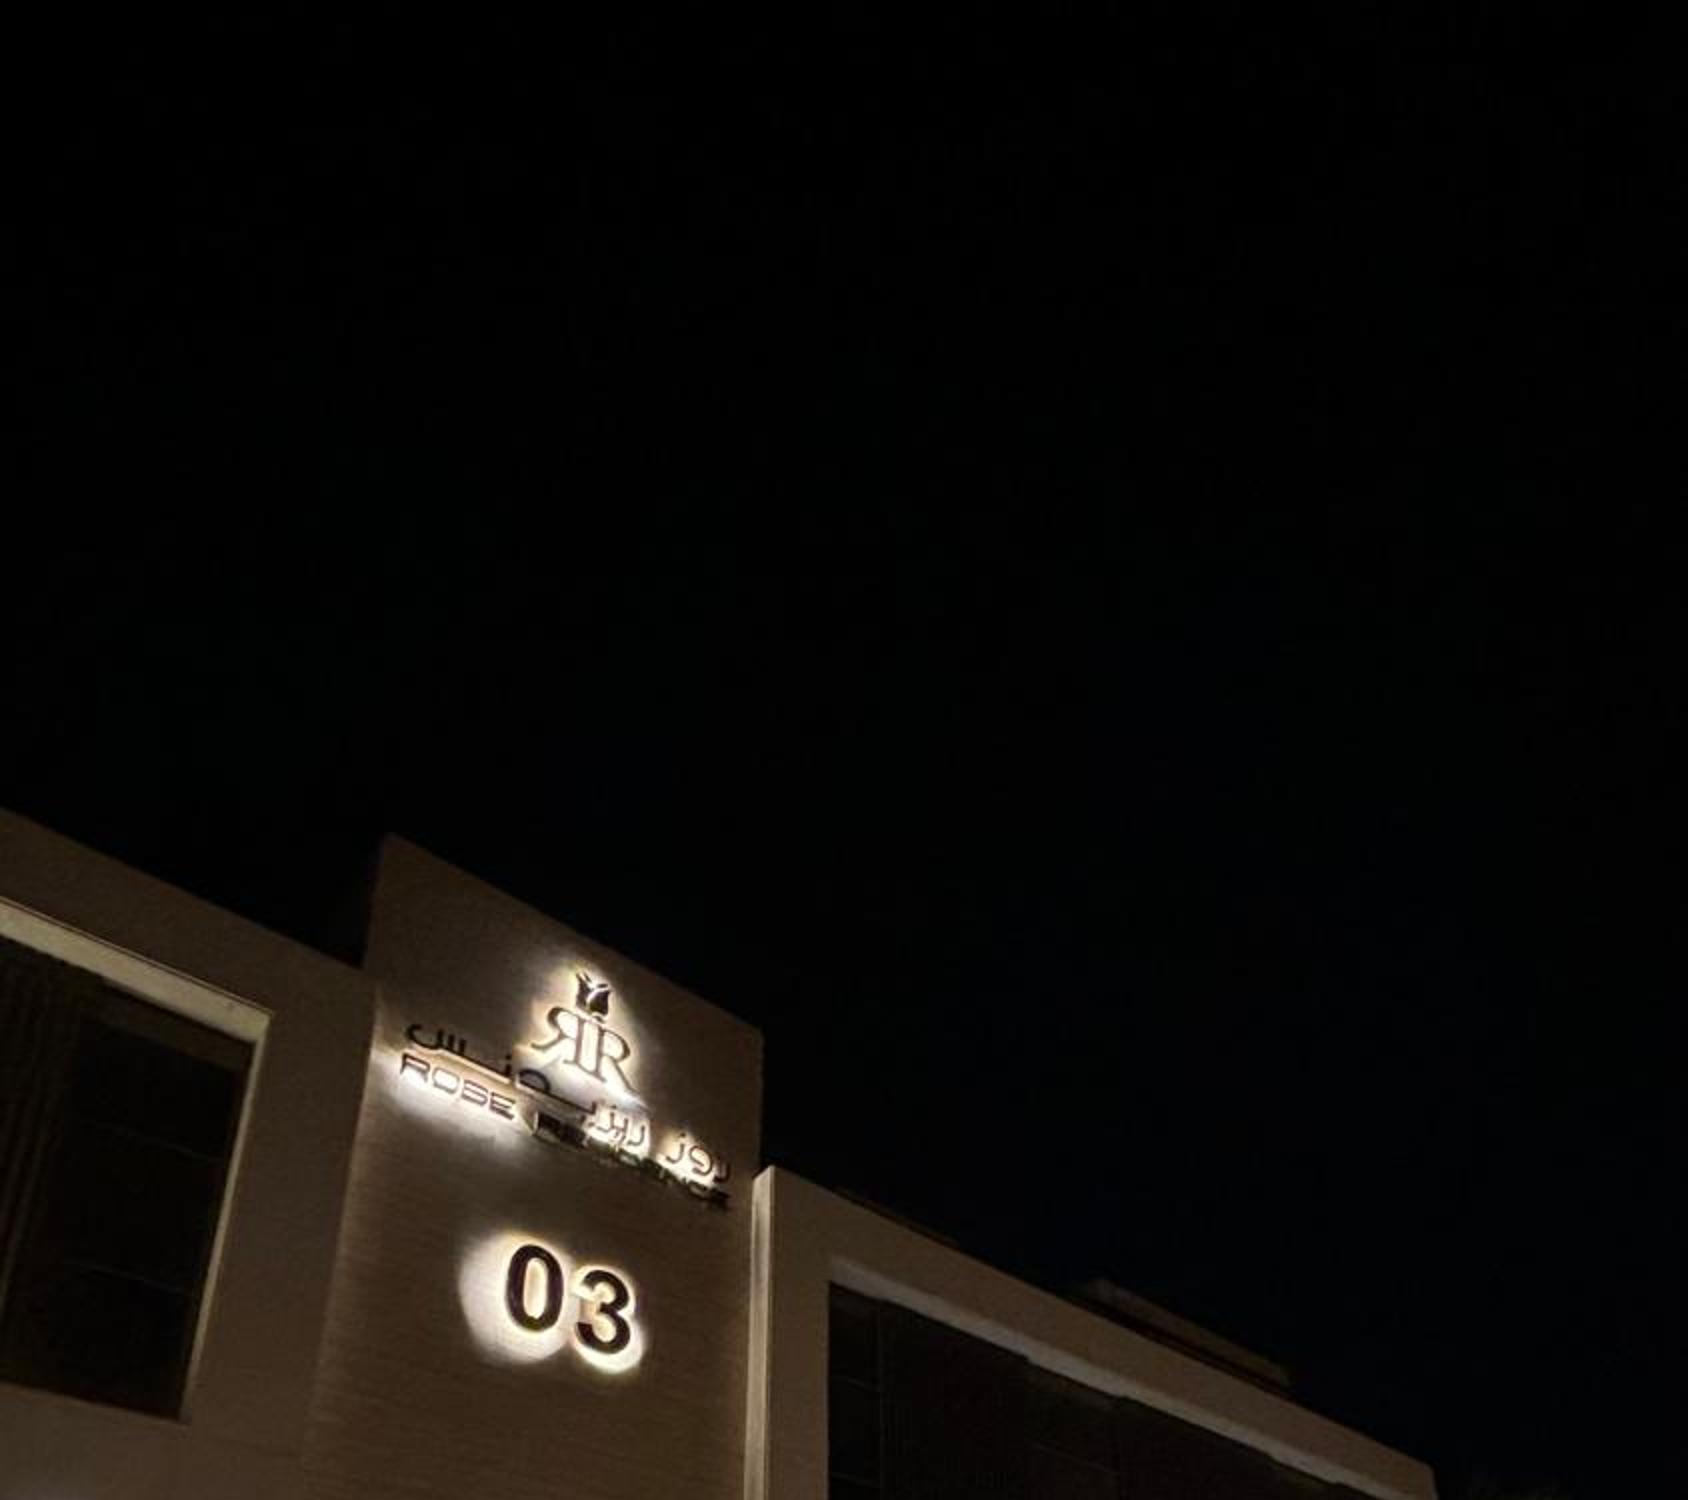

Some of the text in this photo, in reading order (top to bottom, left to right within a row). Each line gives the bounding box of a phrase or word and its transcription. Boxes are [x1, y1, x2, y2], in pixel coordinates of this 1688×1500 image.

[401, 1053, 516, 1120] ROSE
[666, 1132, 731, 1182] روز
[505, 1244, 631, 1354] 03
